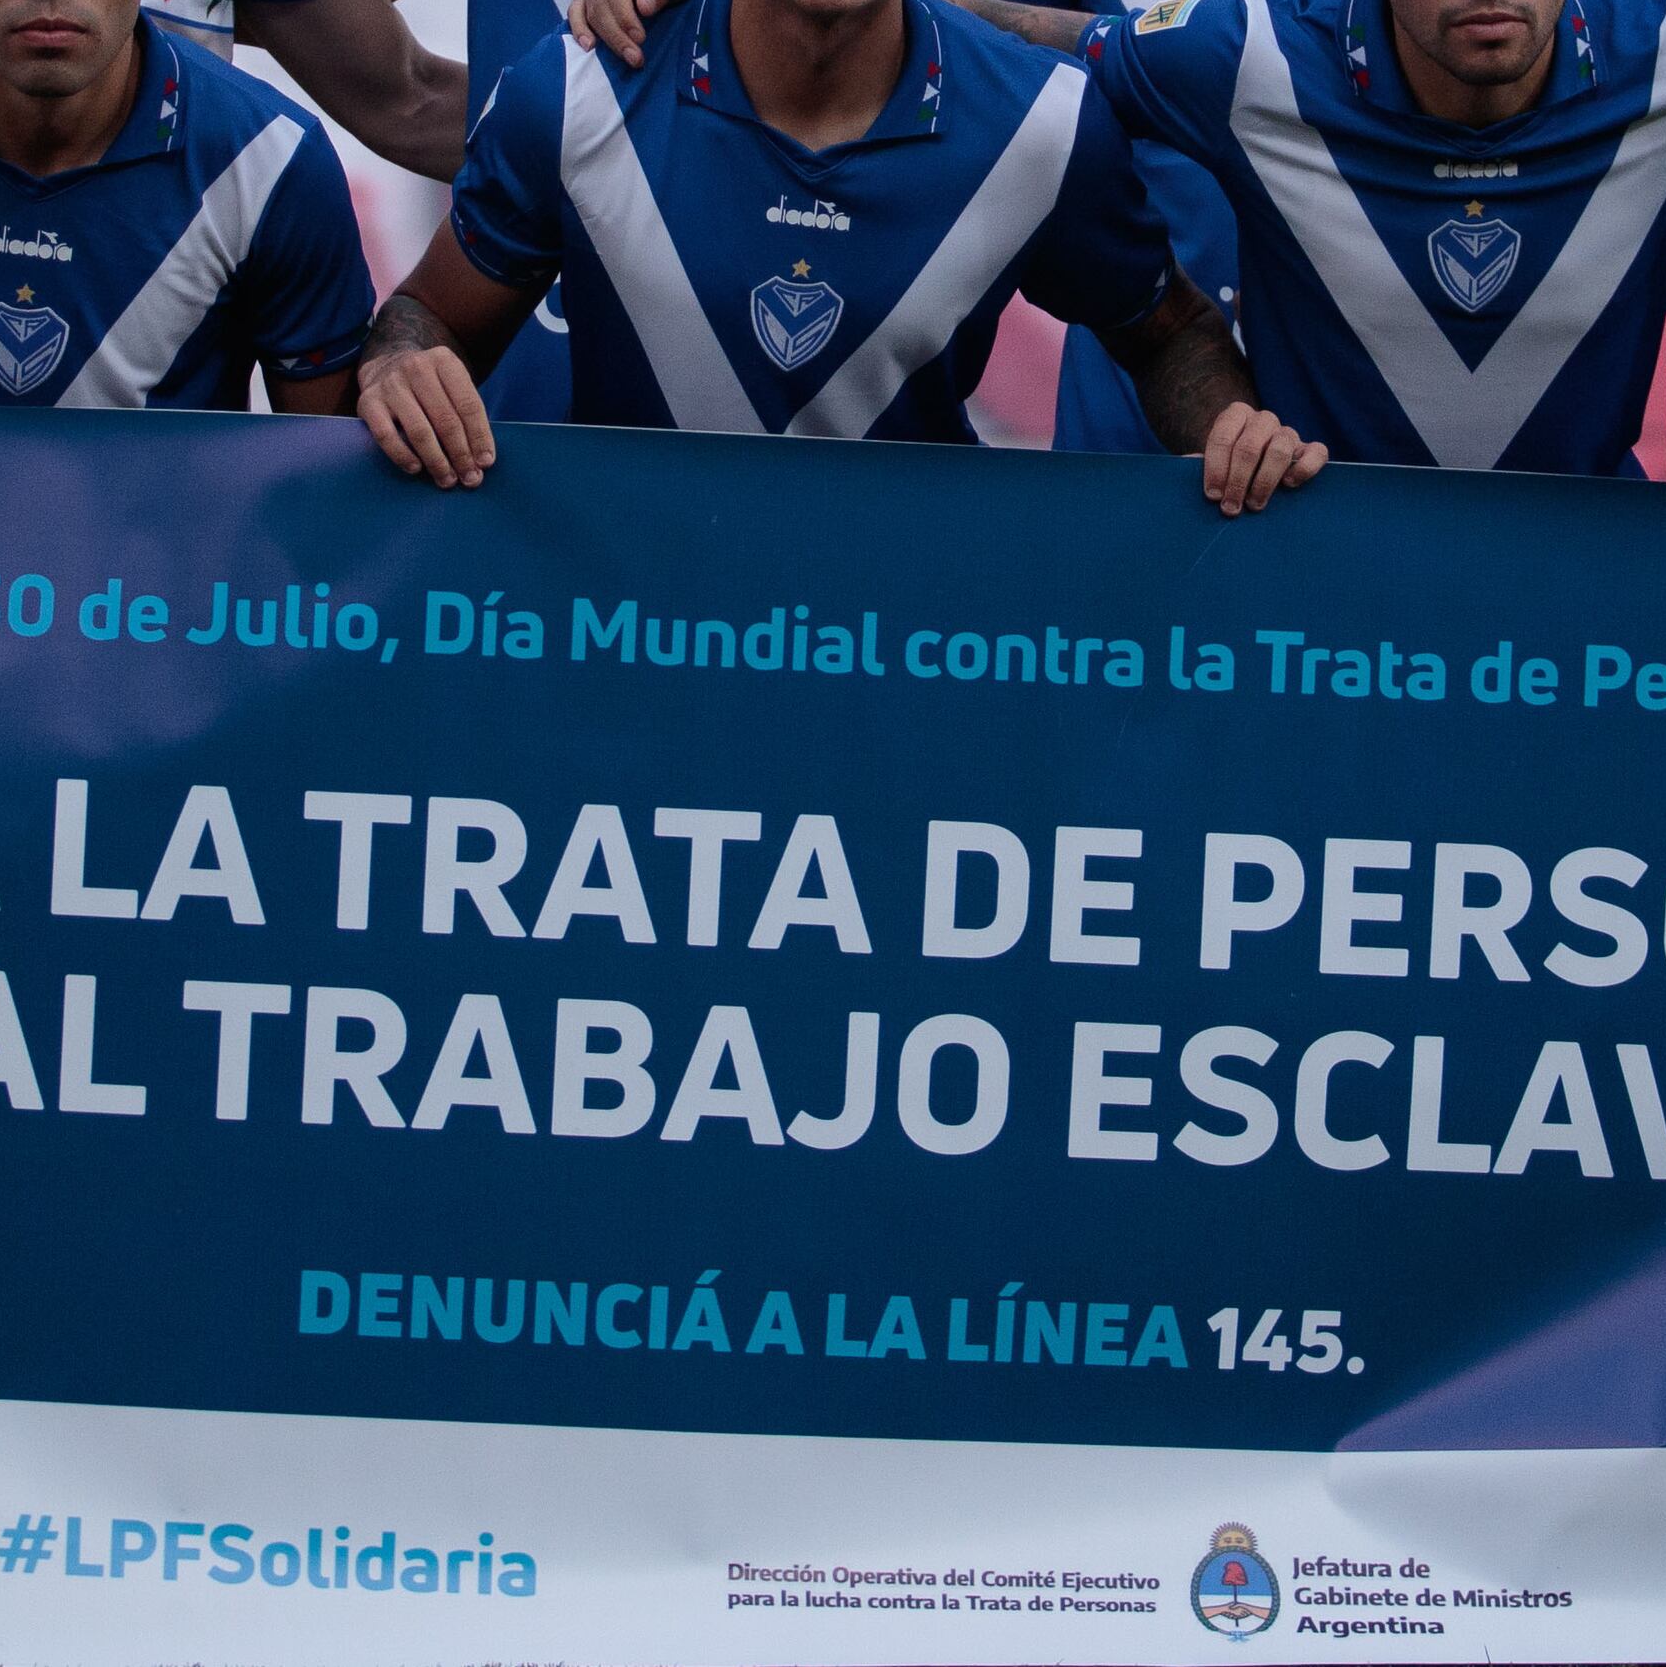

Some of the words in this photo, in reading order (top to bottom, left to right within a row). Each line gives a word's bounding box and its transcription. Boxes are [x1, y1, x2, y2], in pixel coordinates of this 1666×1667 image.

[765, 194, 851, 231] diadora
[77, 577, 170, 644] de
[185, 581, 399, 663] Julio,
[424, 590, 544, 659] Día
[571, 597, 885, 676] Mundial
[905, 626, 1144, 688] contra
[1169, 625, 1235, 692] la
[1255, 629, 1446, 701] Trata
[1470, 640, 1559, 706] de
[51, 778, 265, 925] LA
[304, 791, 872, 954] TRATA
[922, 820, 1143, 966] DE
[183, 980, 1010, 1155] TRABAJO
[299, 1269, 731, 1352] DENUNCIÁ
[745, 1291, 804, 1355] A
[825, 1293, 926, 1360] LA
[947, 1282, 1188, 1368] LÍNEA
[1207, 1308, 1366, 1376] 145.
[727, 1562, 826, 1584] Dirección
[832, 1565, 937, 1587] Operativa
[943, 1567, 976, 1587] del
[981, 1569, 1056, 1589] Comité
[1061, 1571, 1161, 1592] Ejecutivo
[1292, 1556, 1392, 1579] Jefatura
[1399, 1557, 1431, 1579] de
[727, 1593, 775, 1610] para
[781, 1590, 800, 1607] la
[805, 1591, 862, 1609] lucha
[867, 1594, 936, 1610] contra
[941, 1593, 960, 1610] la
[966, 1595, 1023, 1612] Trata
[1028, 1595, 1055, 1612] de
[1060, 1596, 1157, 1614] Personas
[1294, 1586, 1409, 1607] Gabinete
[1415, 1587, 1447, 1607] de
[1453, 1588, 1573, 1609] Ministros
[1296, 1616, 1445, 1639] Argentina
